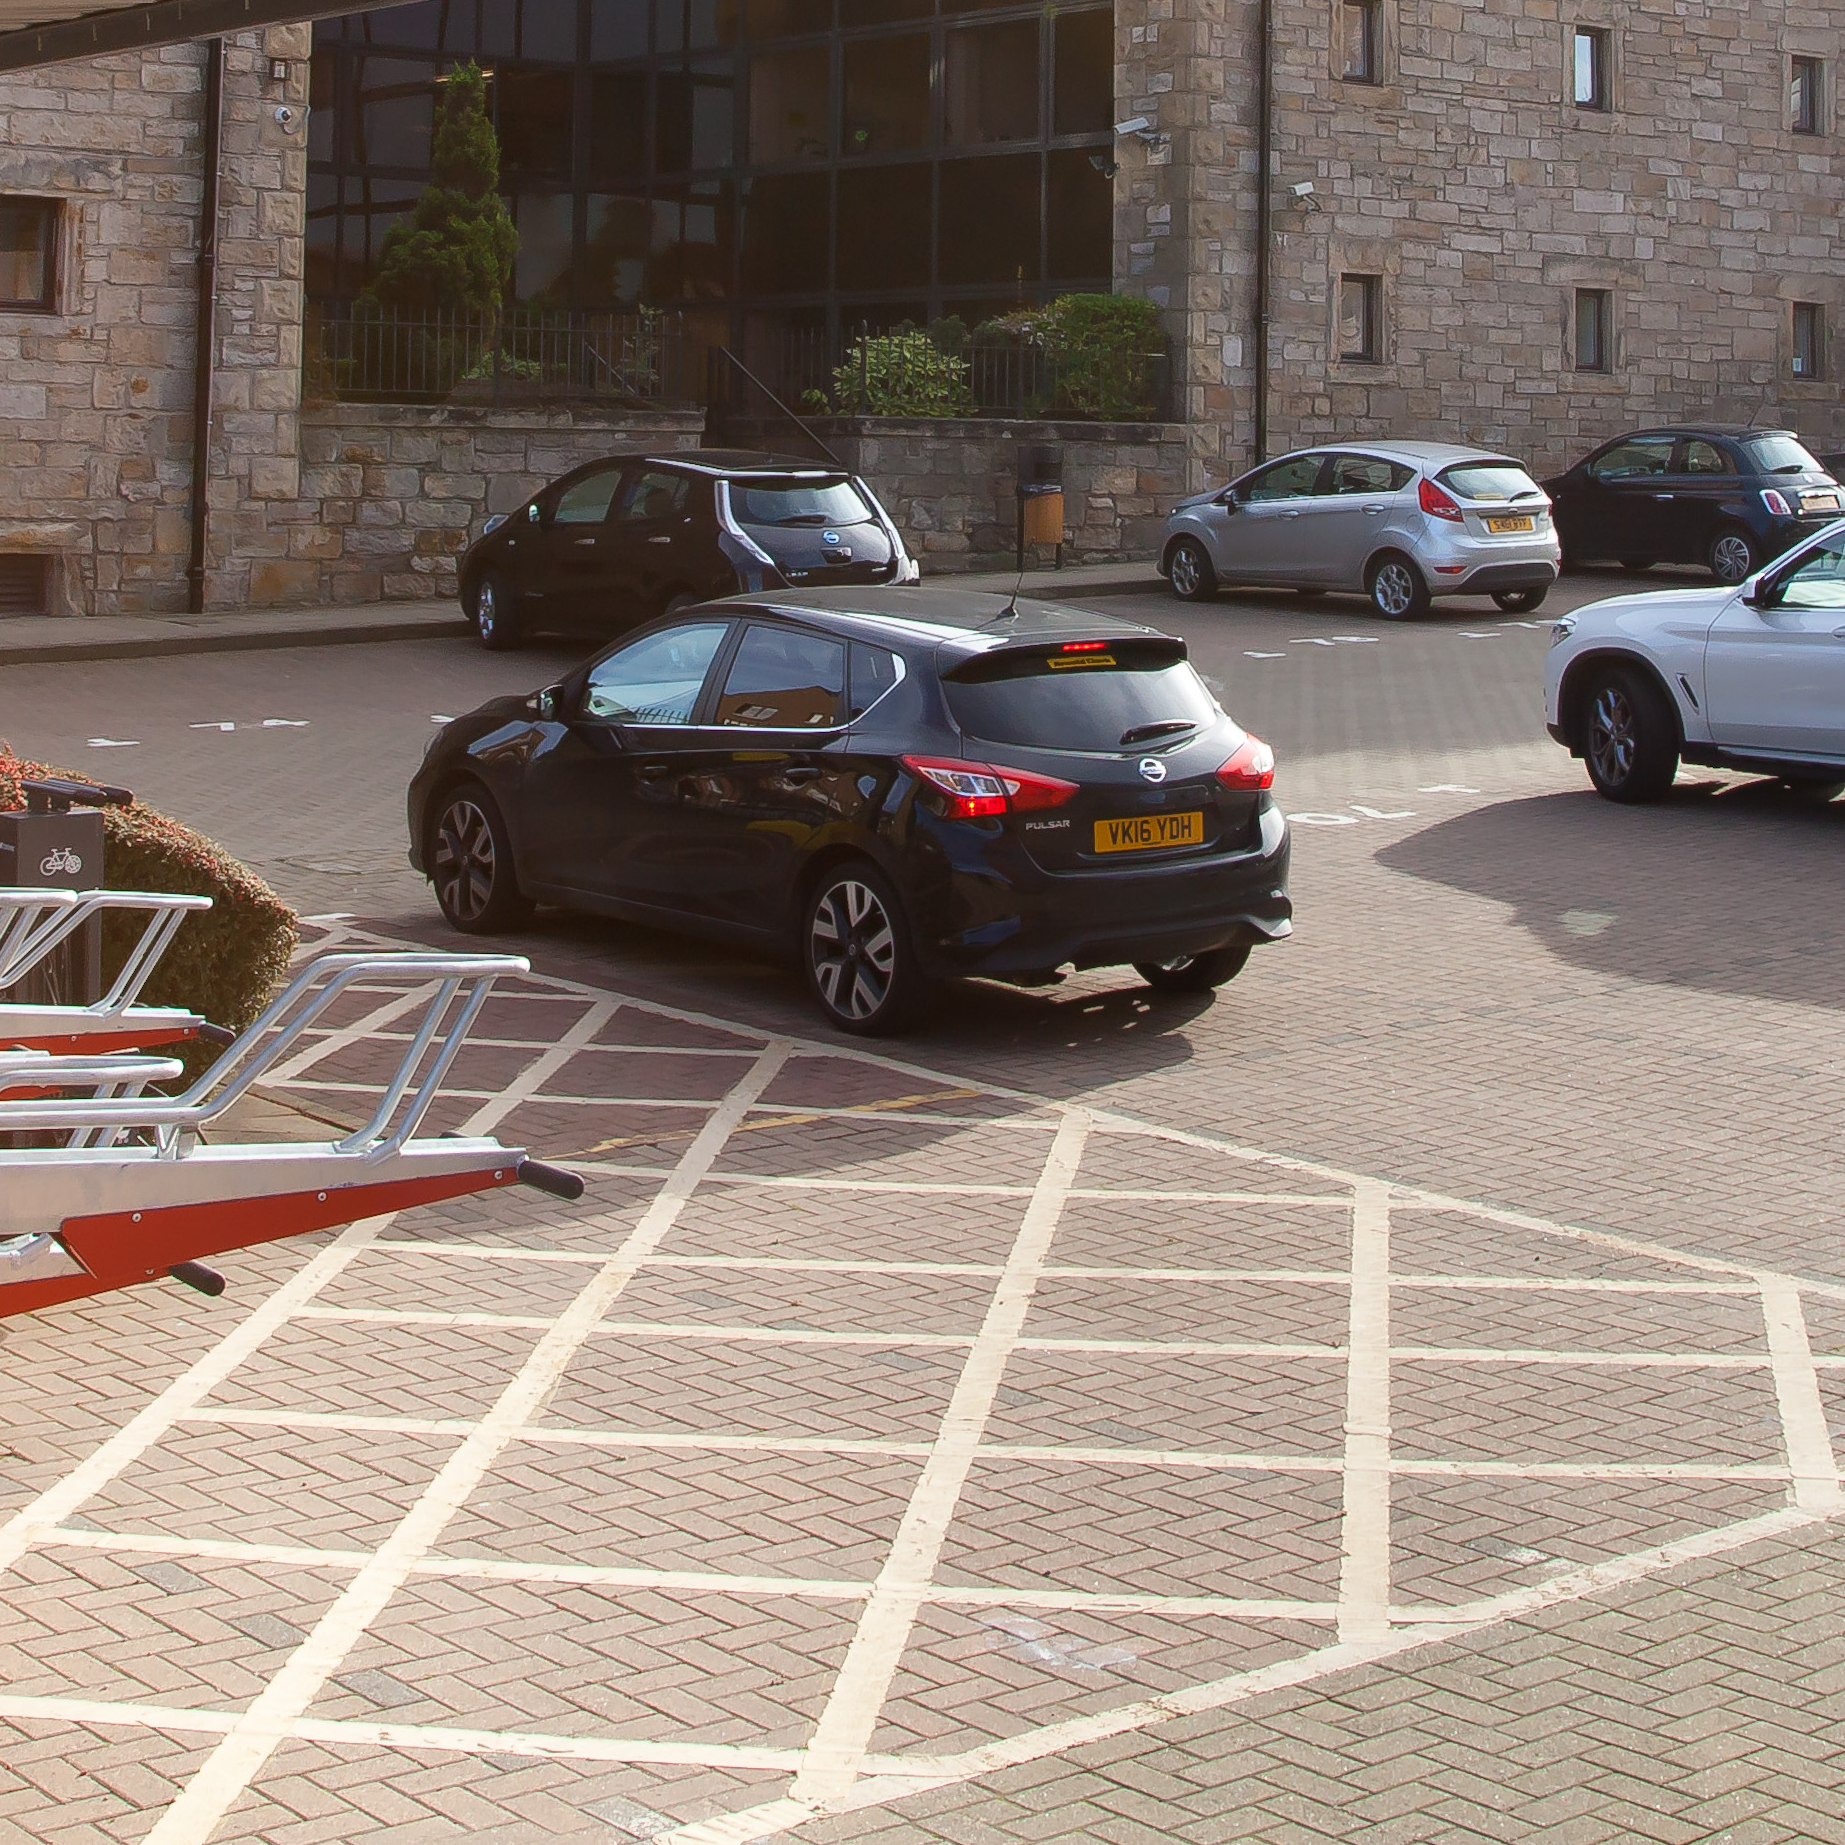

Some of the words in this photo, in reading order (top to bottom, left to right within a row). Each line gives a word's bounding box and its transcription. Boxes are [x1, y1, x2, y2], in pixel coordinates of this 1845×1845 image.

[1024, 819, 1071, 831] PULSAR
[1108, 820, 1151, 845] VK16
[1156, 815, 1192, 841] YDH
